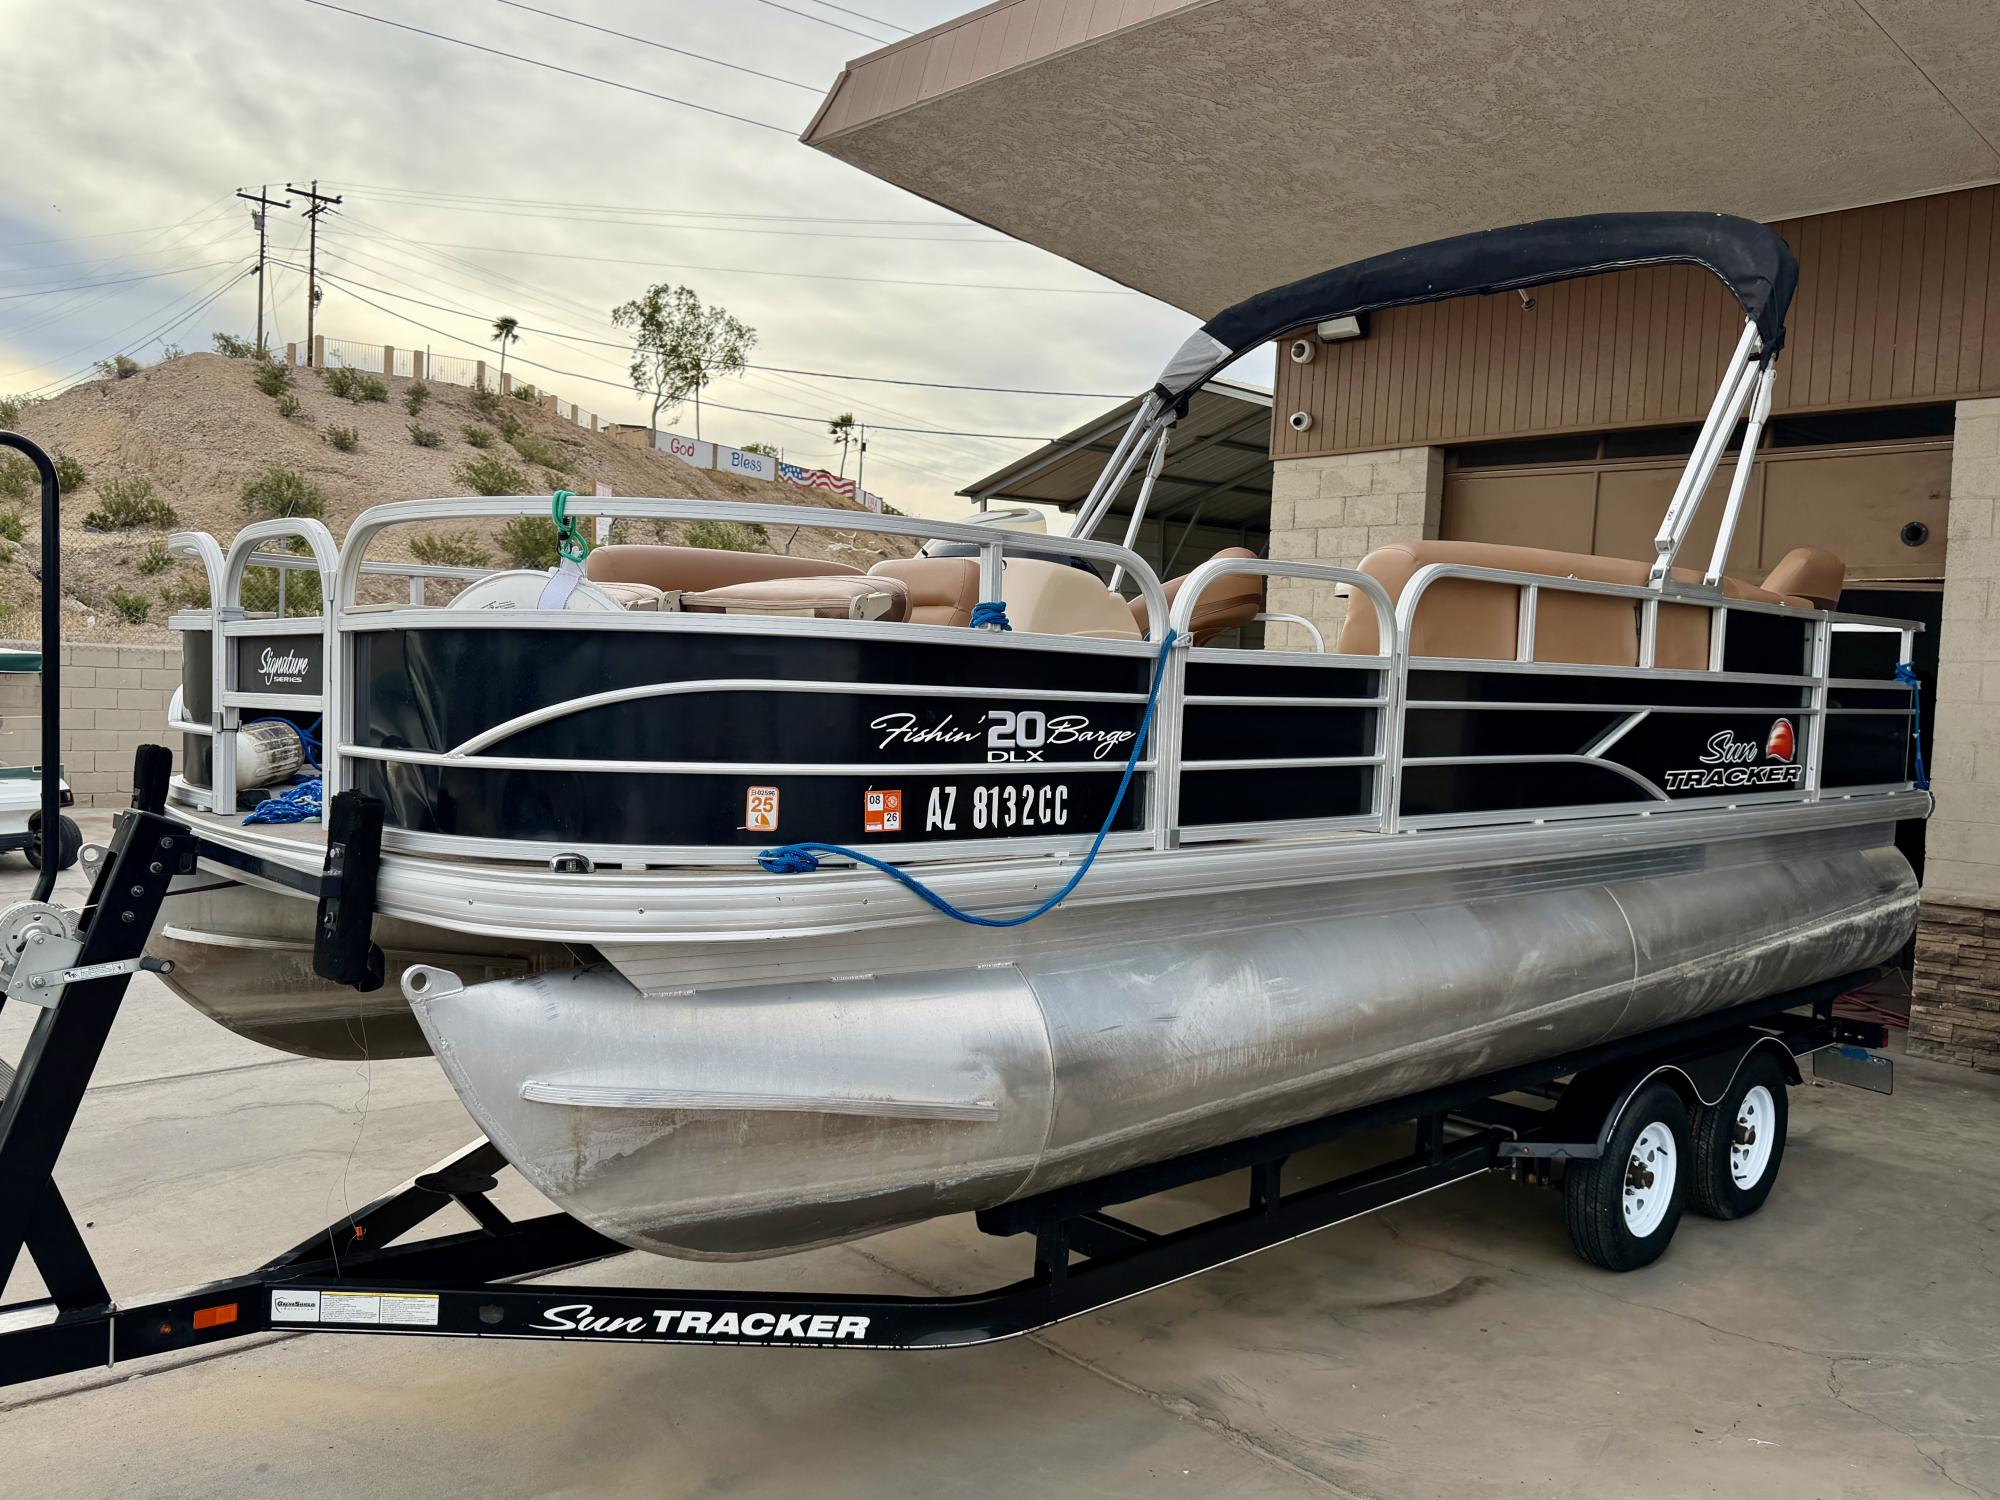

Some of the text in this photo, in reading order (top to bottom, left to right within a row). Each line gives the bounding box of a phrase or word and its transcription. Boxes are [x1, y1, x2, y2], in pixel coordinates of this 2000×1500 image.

[670, 438, 762, 472] God Bless
[257, 646, 309, 686] Signature
[870, 710, 1136, 760] Fishin' 20 Barge
[1699, 730, 1759, 764] Sun
[987, 750, 1045, 762] DLX
[1665, 765, 1802, 790] TRACKER
[751, 796, 774, 813] 25
[869, 795, 881, 805] 08
[886, 812, 898, 822] 26
[925, 784, 1068, 831] AZ 8132CC
[528, 1304, 871, 1339] Sun TRACKER
